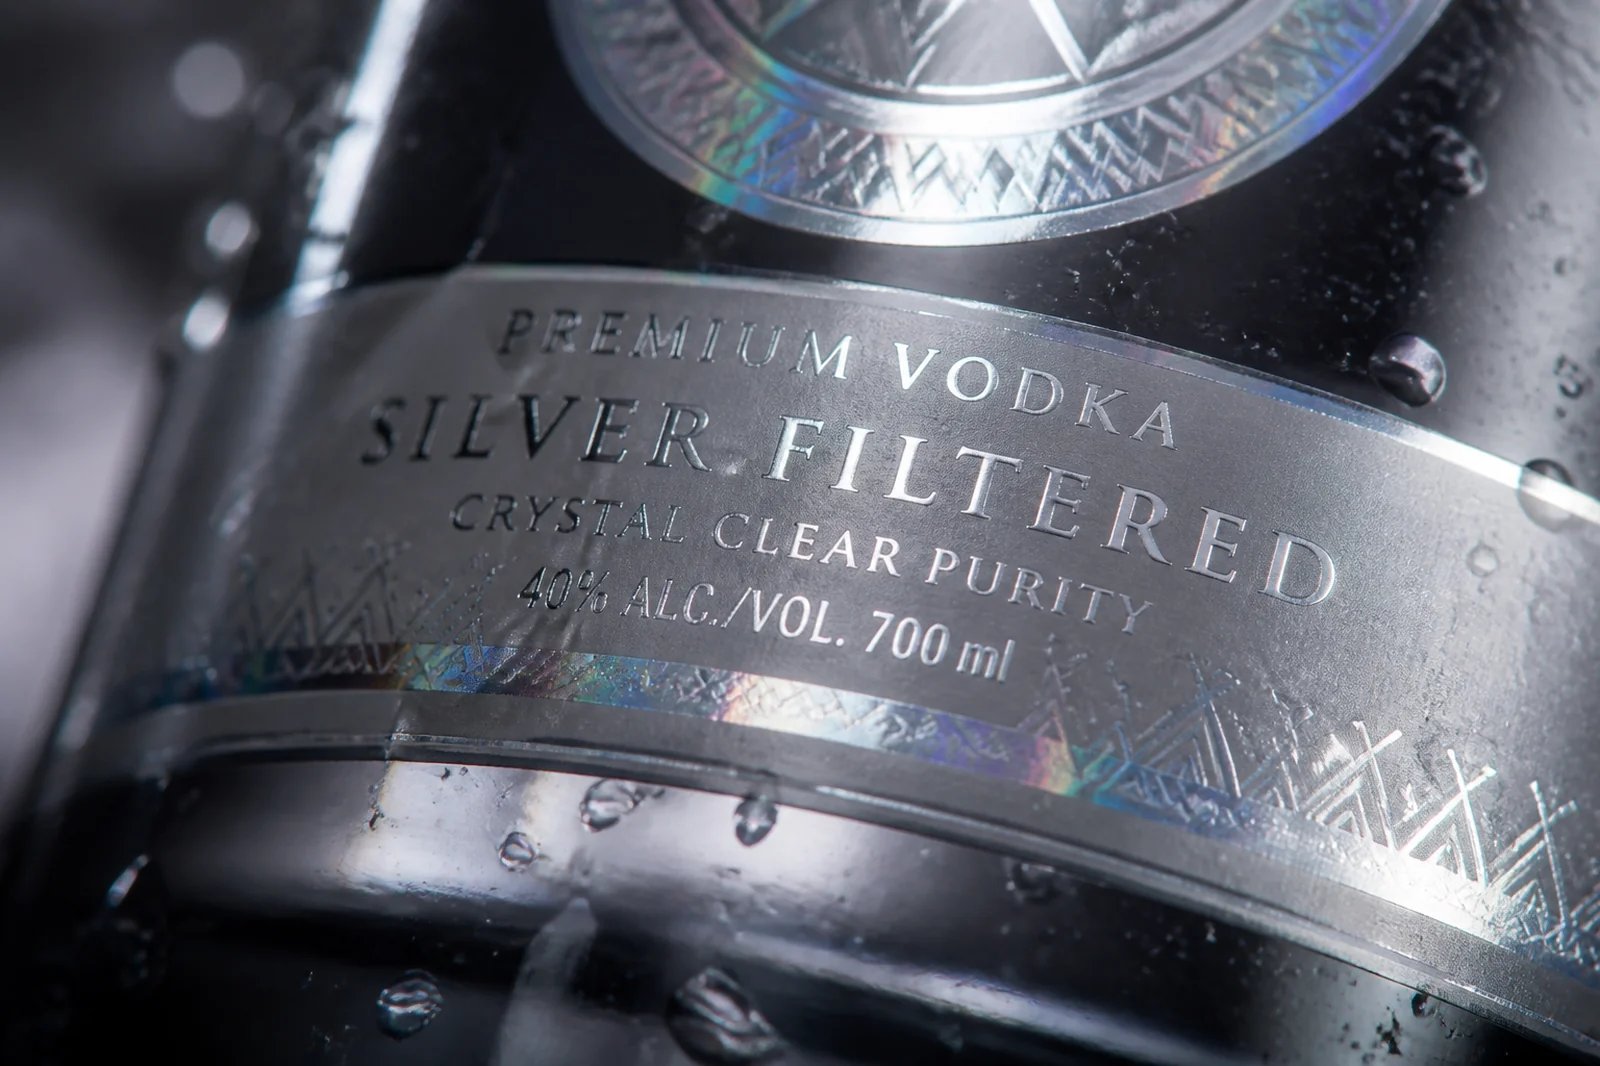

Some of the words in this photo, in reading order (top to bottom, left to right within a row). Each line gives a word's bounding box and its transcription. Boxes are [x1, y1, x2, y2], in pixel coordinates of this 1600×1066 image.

[497, 308, 853, 379] PREMIUM
[893, 342, 1179, 450] VODKA
[360, 393, 713, 472] SILVER
[761, 414, 1337, 607] FILTERED
[451, 493, 688, 543] CRYSTAL
[712, 512, 901, 577] CLEAR
[924, 547, 1154, 635] PURITY
[517, 566, 611, 614] 40%
[619, 575, 845, 646] ALC./VOL.
[865, 609, 951, 666] 700
[955, 638, 1016, 683] ml
